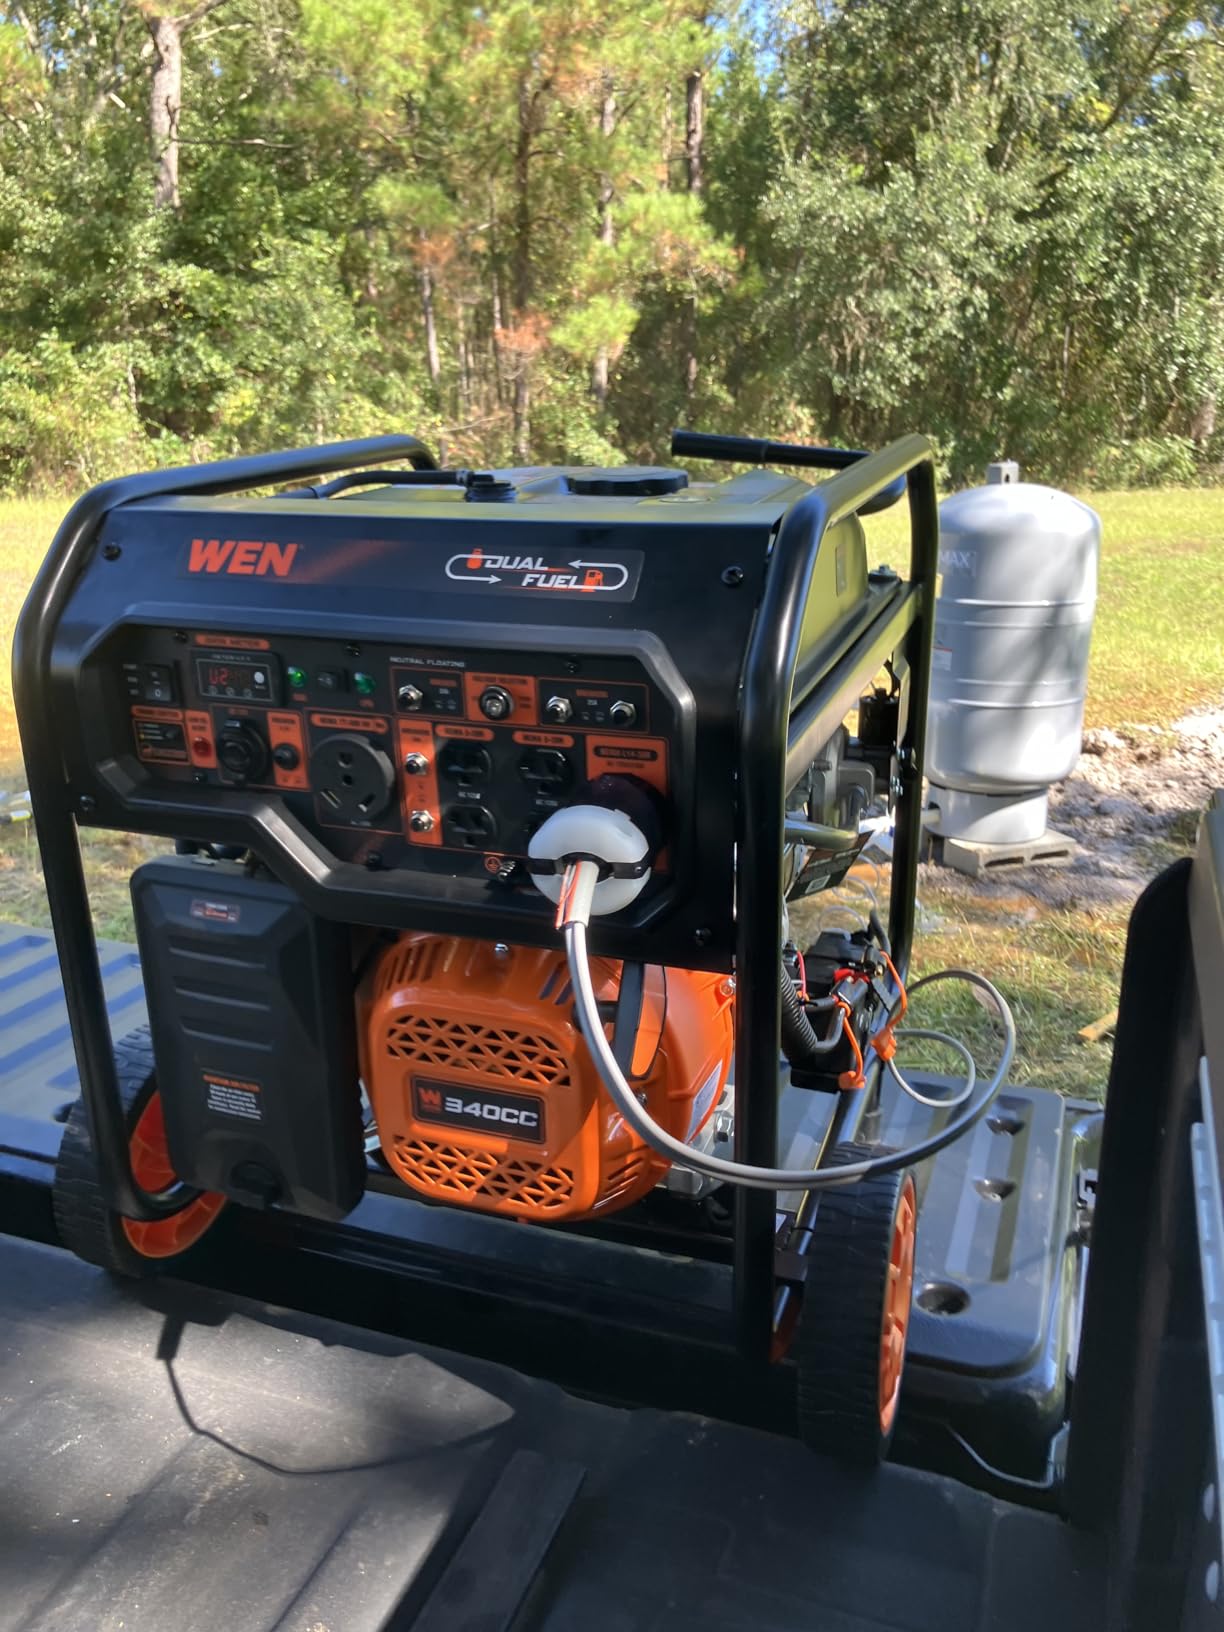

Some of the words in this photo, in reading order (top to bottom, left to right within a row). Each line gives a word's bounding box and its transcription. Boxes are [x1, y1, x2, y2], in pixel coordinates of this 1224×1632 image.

[188, 538, 299, 577] WEN
[484, 556, 550, 571] DUAL
[521, 573, 583, 589] FUEL
[389, 656, 425, 665] NEUTRAL
[426, 659, 466, 668] FLOATING
[444, 1097, 539, 1127] 340CC
